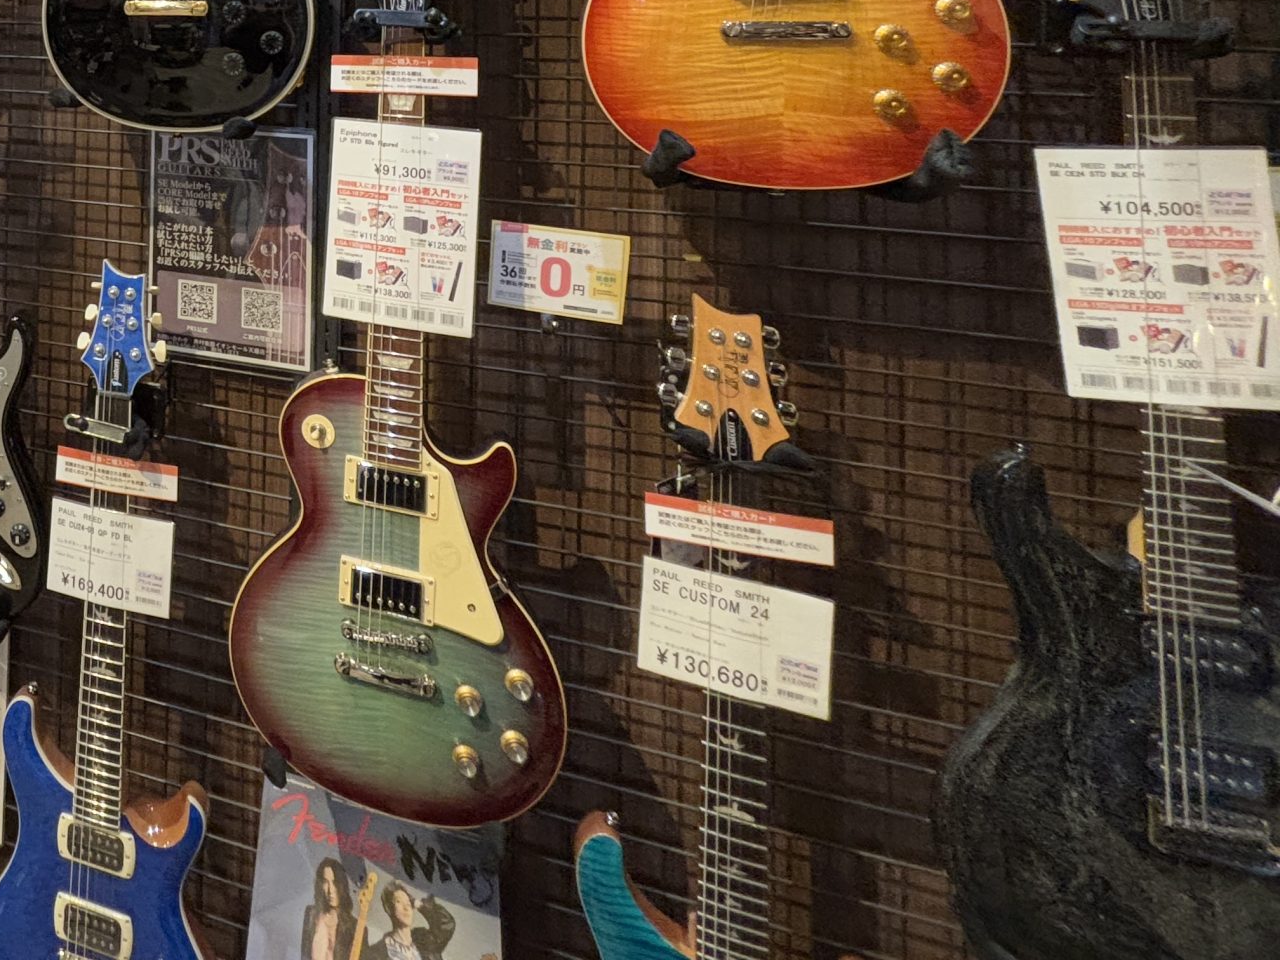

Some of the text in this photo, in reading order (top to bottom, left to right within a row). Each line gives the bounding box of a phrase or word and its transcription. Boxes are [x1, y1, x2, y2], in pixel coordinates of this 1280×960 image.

[339, 127, 378, 138] Epiphone
[158, 132, 220, 166] PRS
[157, 162, 222, 177] GUITARS
[374, 163, 427, 180] ¥91,300
[1080, 162, 1106, 170] REED
[157, 187, 184, 197] CORE
[1099, 200, 1195, 217] ¥104,500
[427, 240, 465, 252] ¥125,300
[526, 235, 569, 254] 無金利
[500, 264, 518, 279] 36
[540, 256, 585, 298] 0 円
[726, 420, 737, 457] Custom
[57, 506, 134, 531] PAUL REED SMITH
[61, 571, 124, 601] ¥169,400
[652, 567, 770, 606] PAUL REED SMITH
[652, 579, 770, 621] SE CUSTOM 24
[656, 645, 759, 693] ¥130,680
